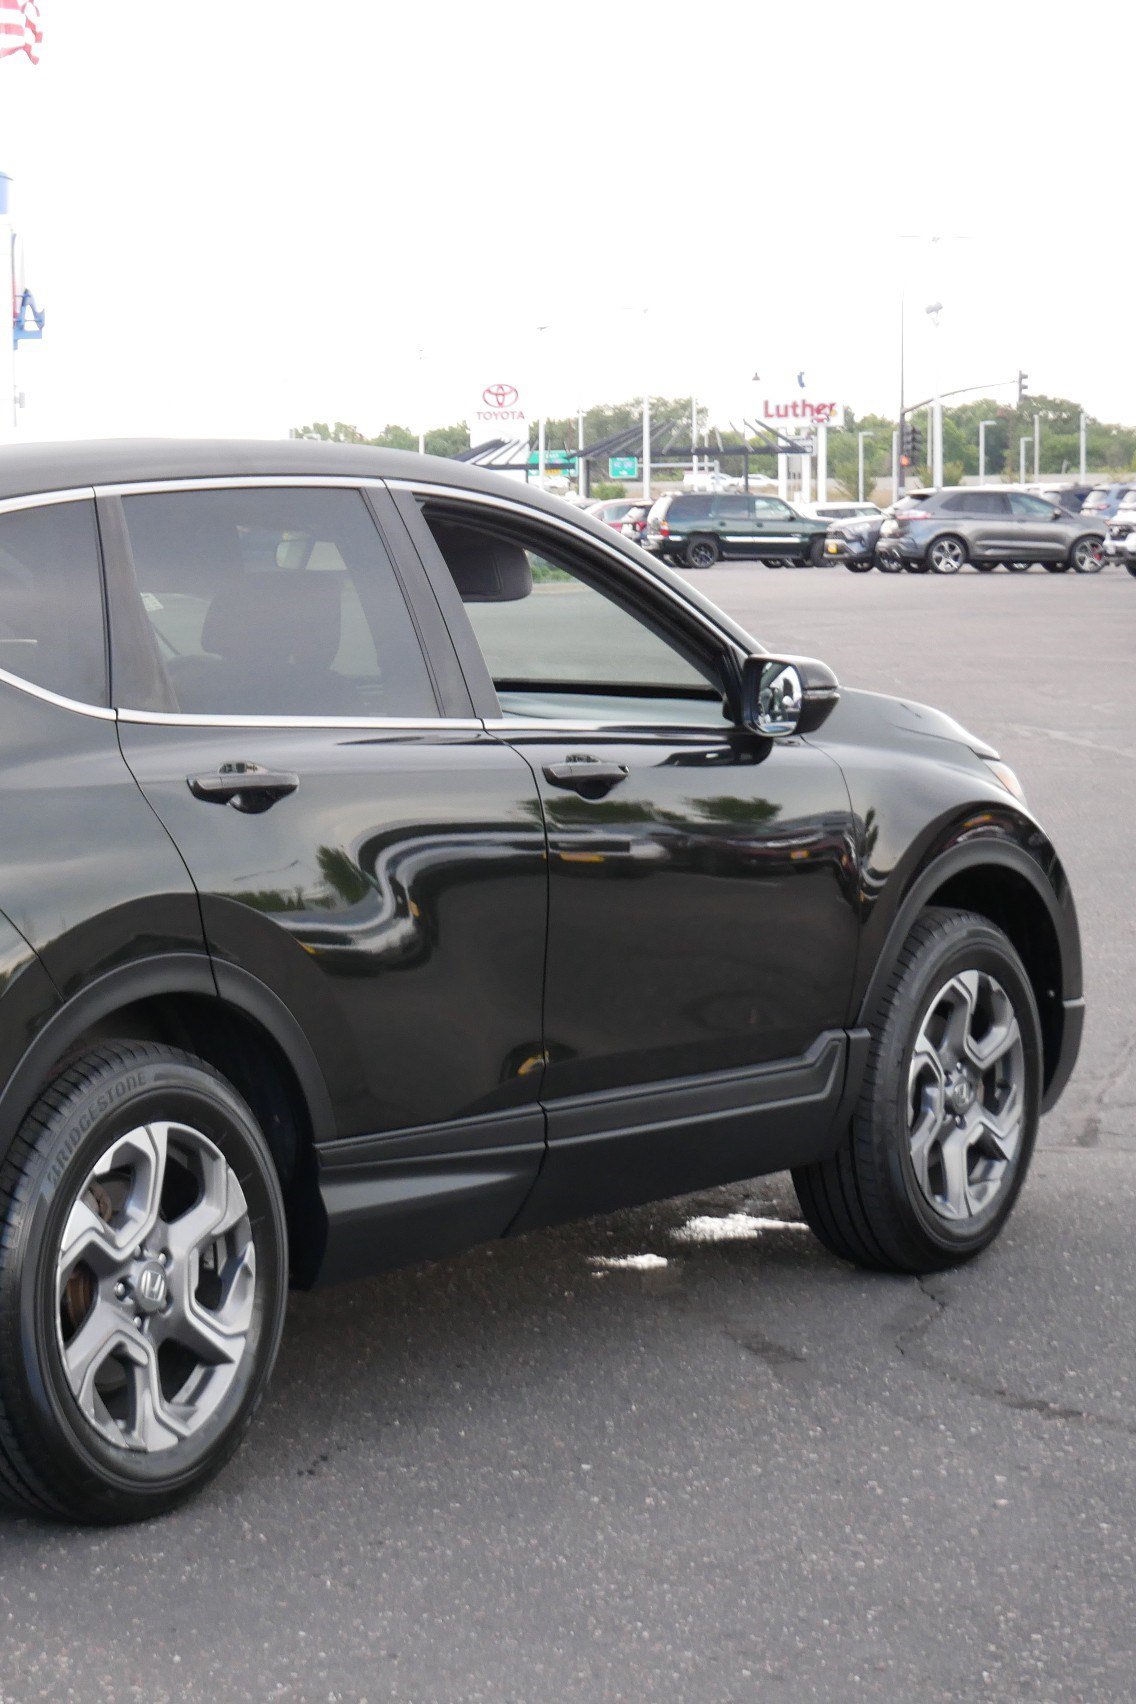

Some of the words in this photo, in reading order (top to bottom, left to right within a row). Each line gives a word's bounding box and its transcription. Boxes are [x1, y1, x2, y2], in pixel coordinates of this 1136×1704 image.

[476, 410, 525, 421] TOYOTA
[764, 399, 836, 419] Luther
[47, 1072, 146, 1183] BRIDGESTONE
